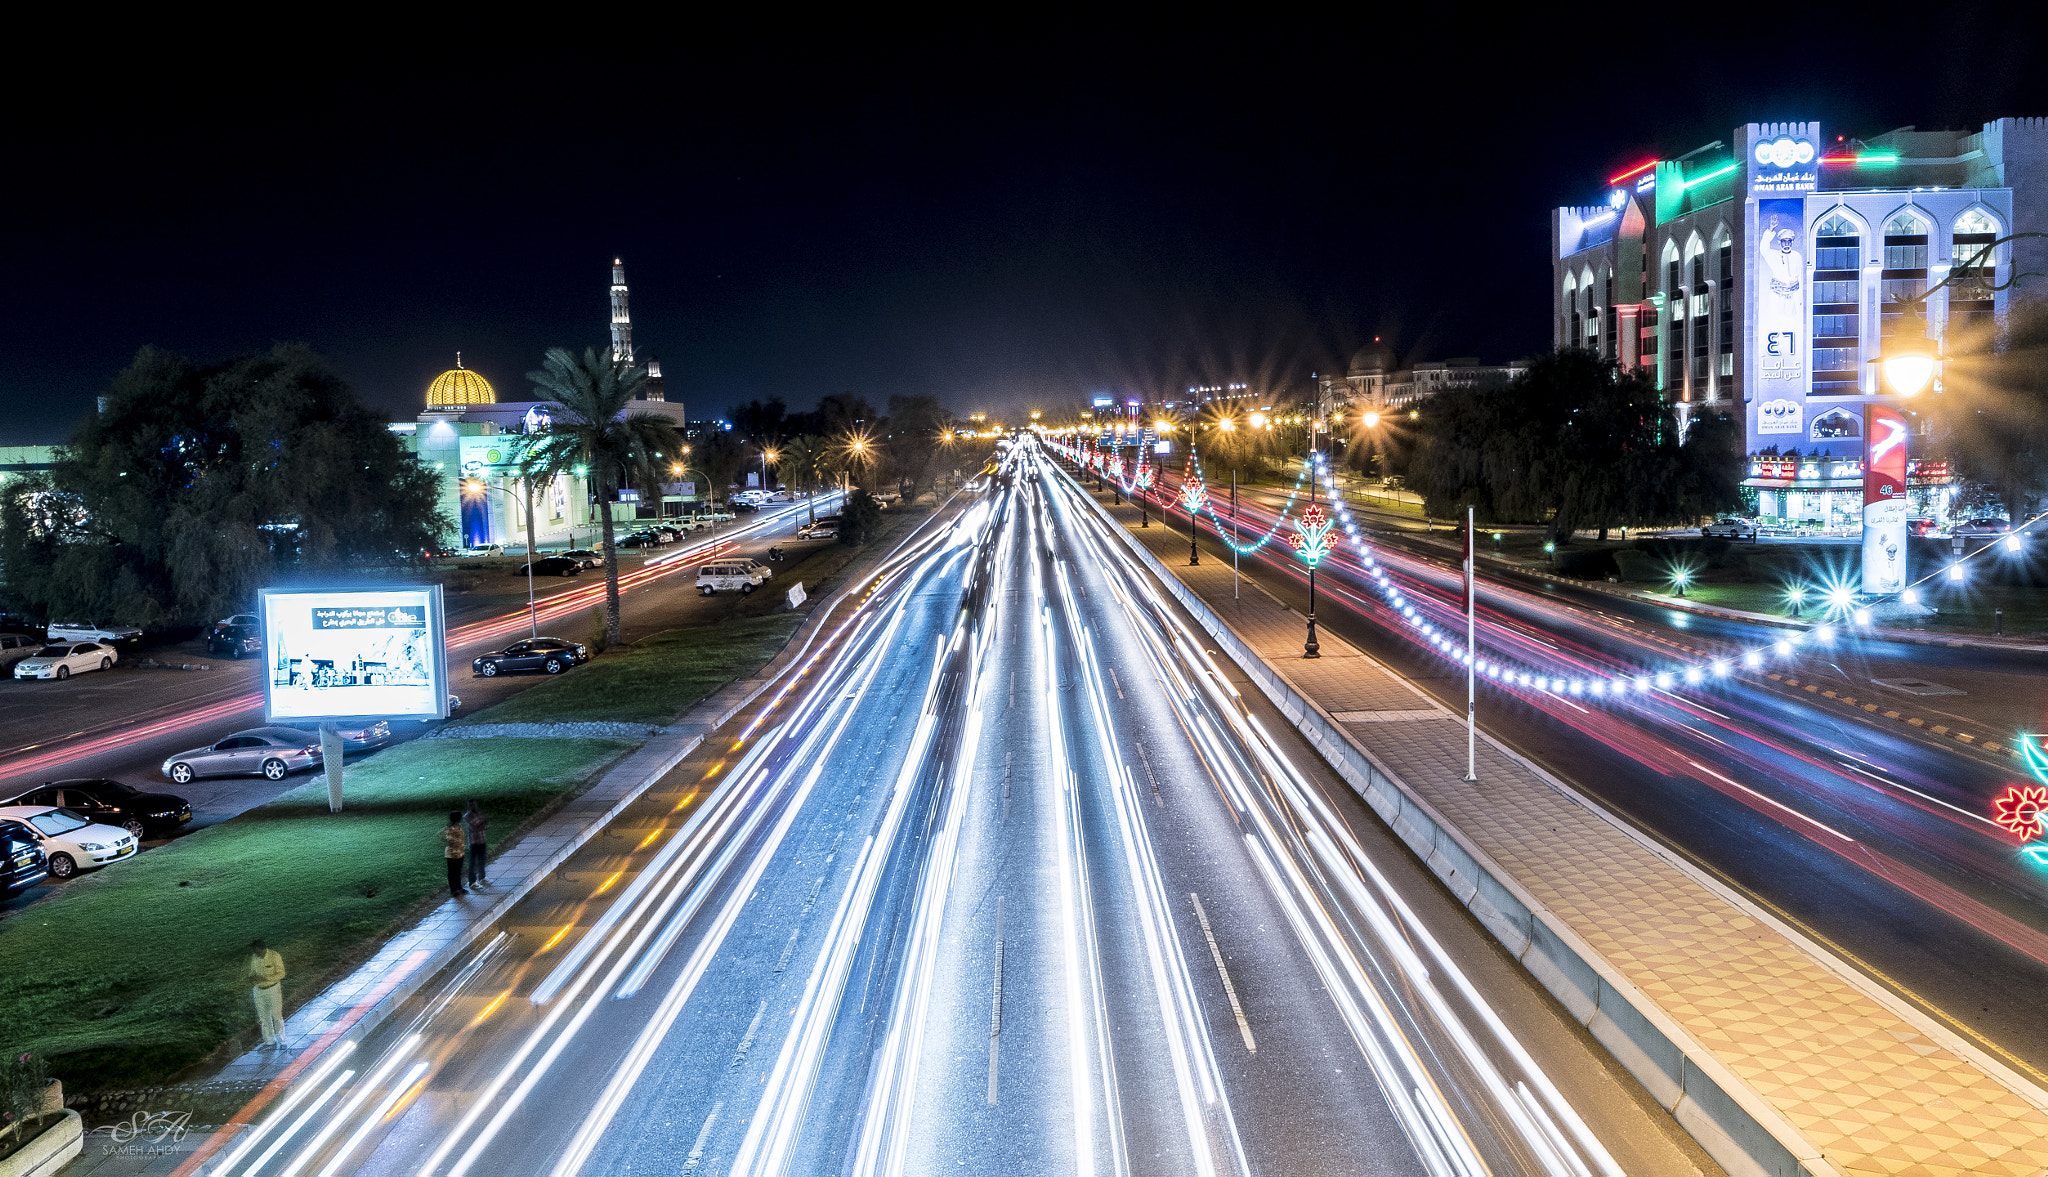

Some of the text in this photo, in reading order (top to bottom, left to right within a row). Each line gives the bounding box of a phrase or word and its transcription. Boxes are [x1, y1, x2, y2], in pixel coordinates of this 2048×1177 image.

[1776, 183, 1794, 191] ARAB
[1767, 331, 1795, 355] ٤٦
[1880, 484, 1893, 496] 46
